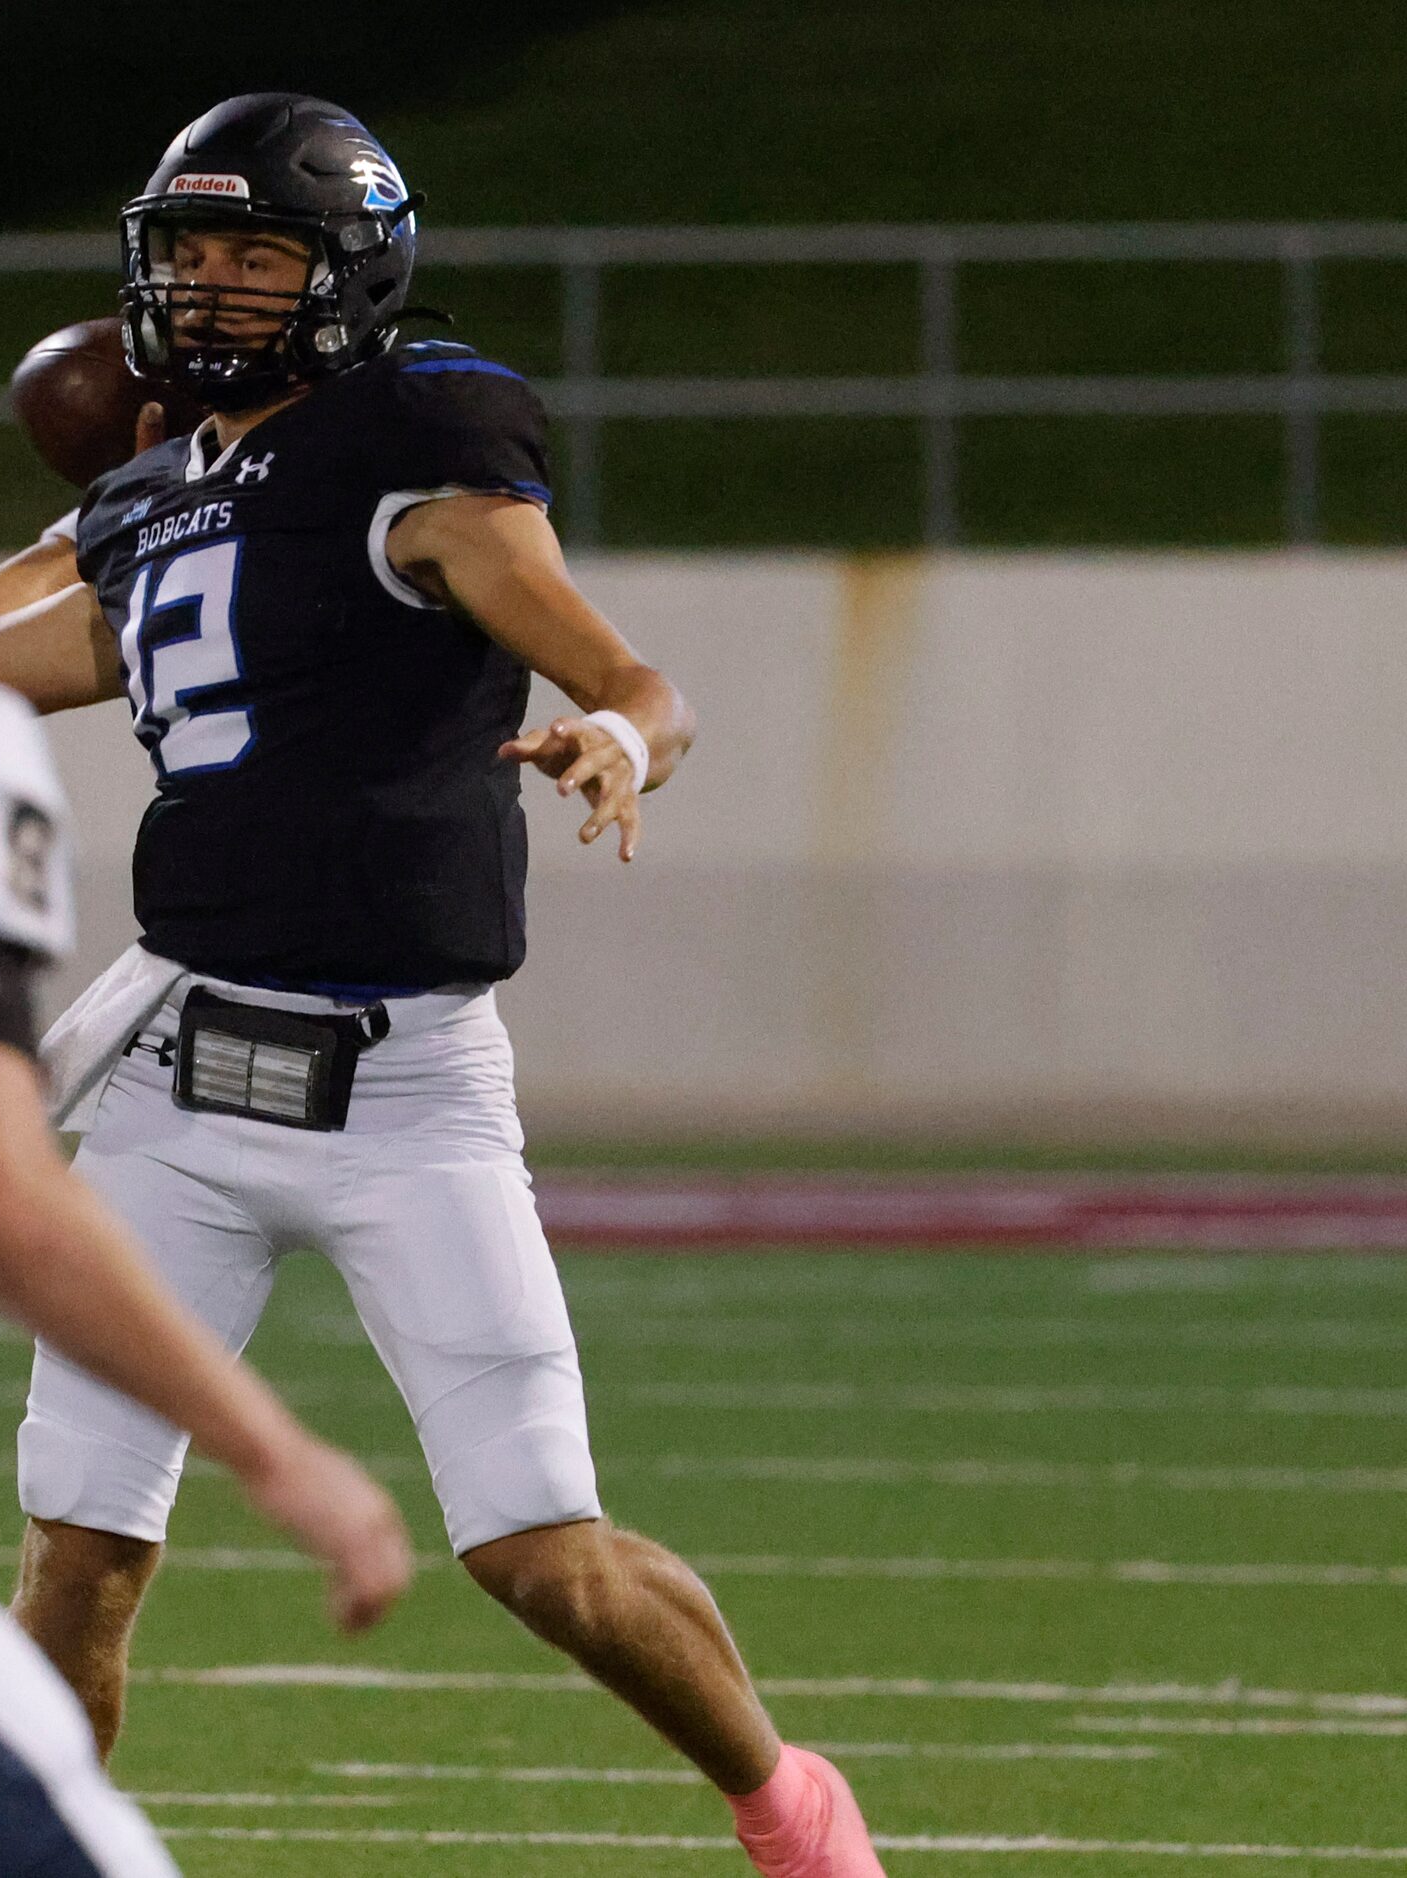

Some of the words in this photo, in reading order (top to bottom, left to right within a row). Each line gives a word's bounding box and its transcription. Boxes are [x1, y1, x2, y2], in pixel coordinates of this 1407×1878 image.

[175, 177, 236, 192] Riddell
[135, 501, 233, 557] BOBCATS
[121, 534, 258, 774] 12
